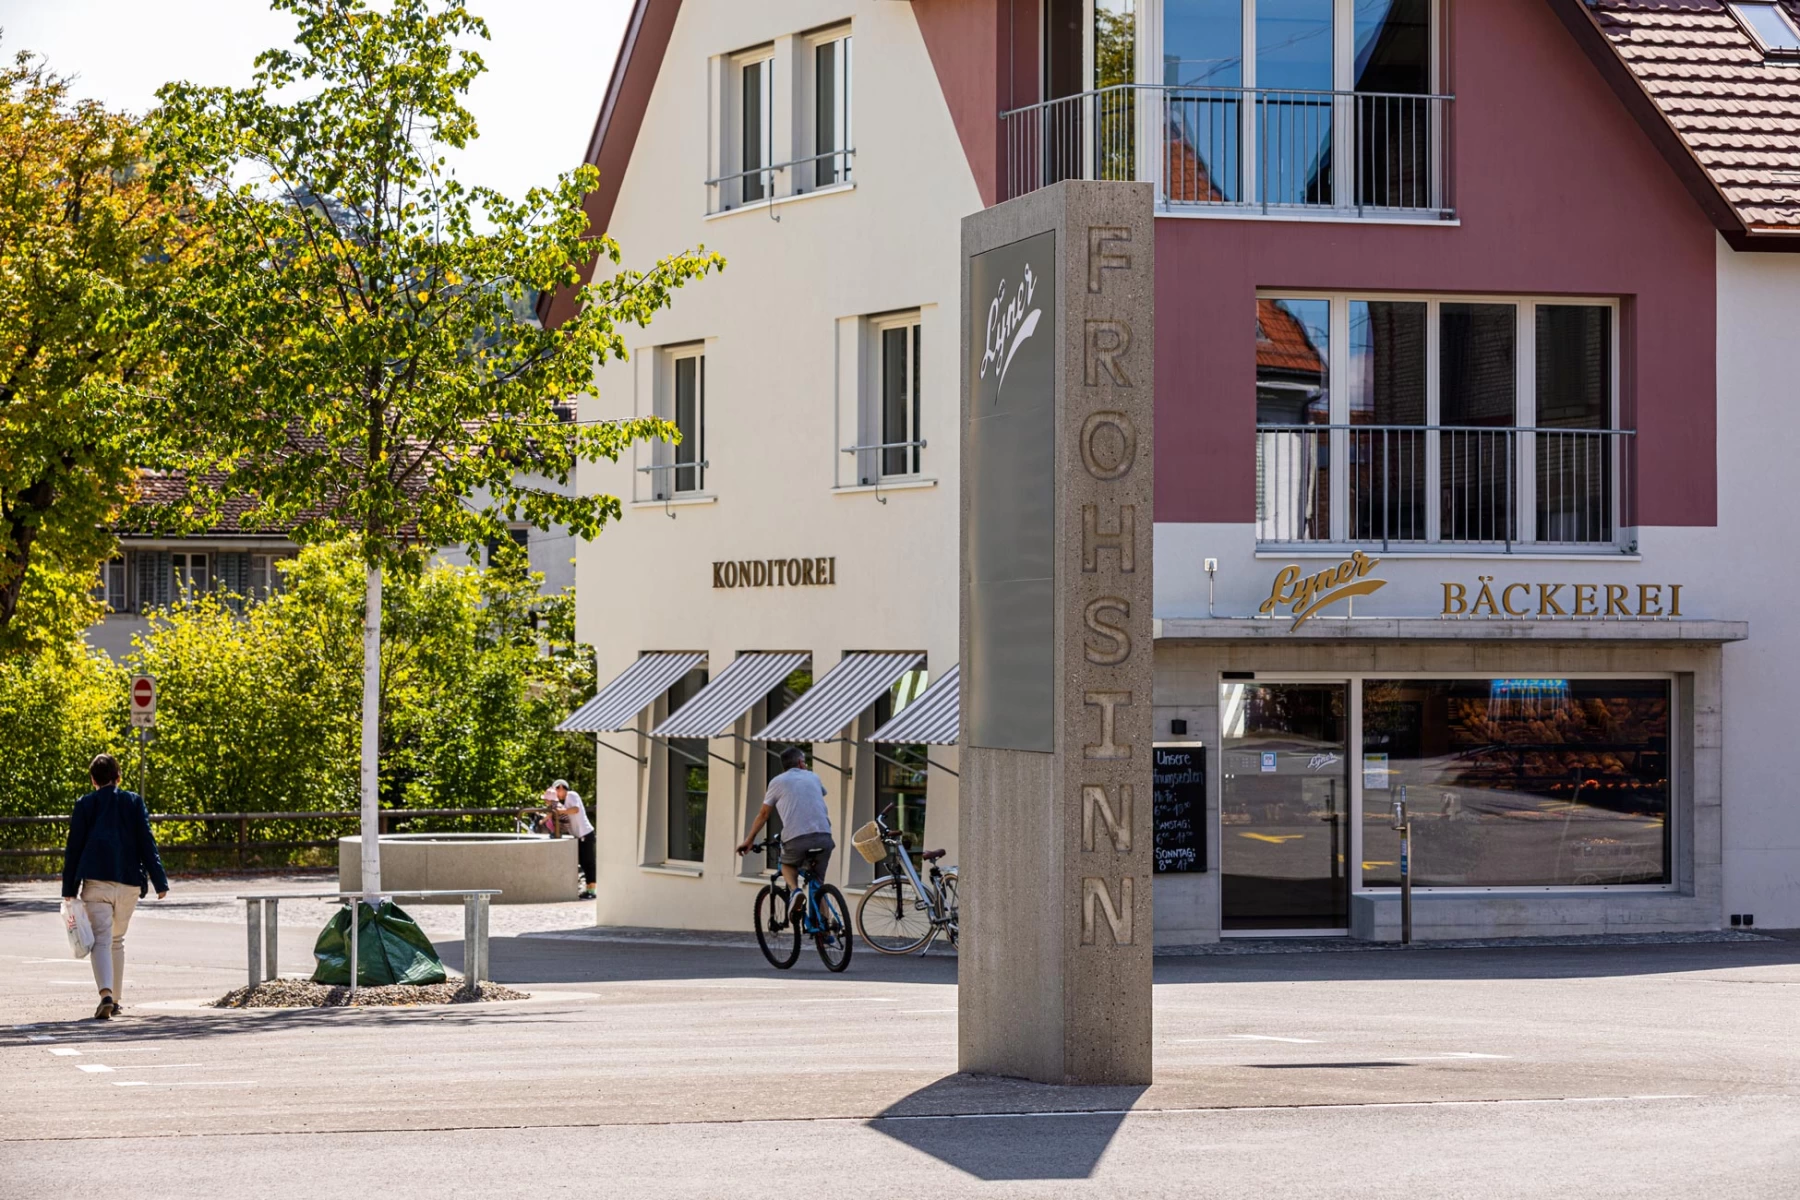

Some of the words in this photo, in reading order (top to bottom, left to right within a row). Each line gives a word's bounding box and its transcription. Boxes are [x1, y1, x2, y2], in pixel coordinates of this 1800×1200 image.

[980, 263, 1038, 380] Lyner
[712, 557, 836, 588] KONDITOREI
[1080, 226, 1137, 946] FROHSINN
[1259, 550, 1380, 614] Lyner
[1441, 576, 1683, 616] BÄCKEREI
[1156, 751, 1192, 766] Unsere
